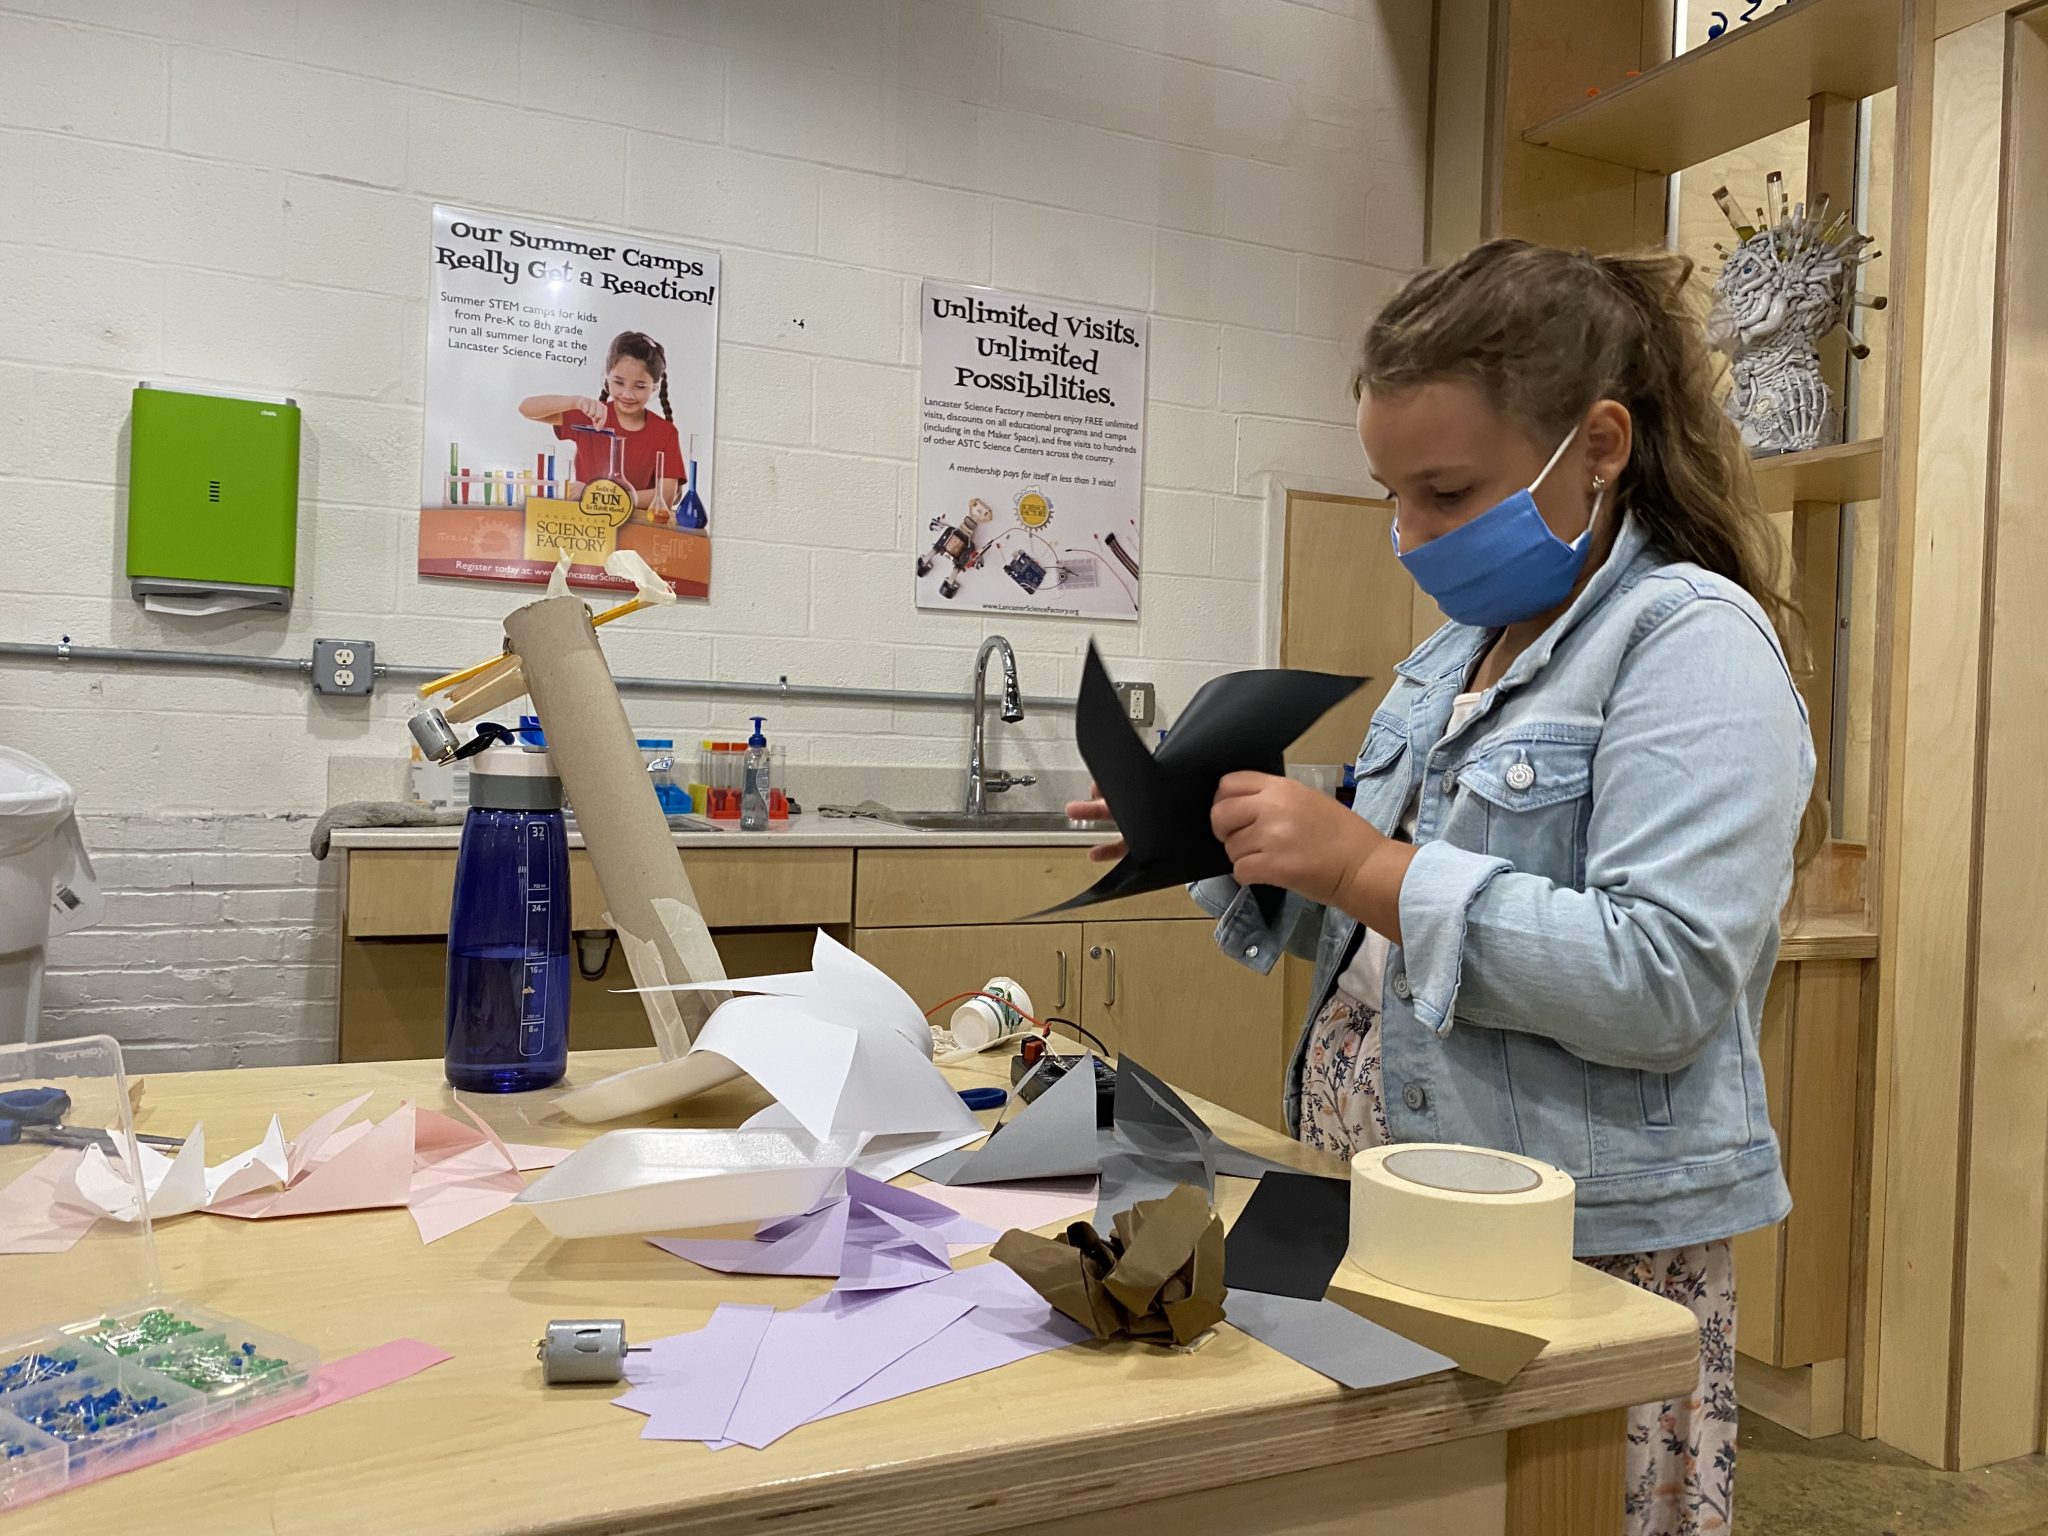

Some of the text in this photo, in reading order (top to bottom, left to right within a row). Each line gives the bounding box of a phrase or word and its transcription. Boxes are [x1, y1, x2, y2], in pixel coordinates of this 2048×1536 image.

[450, 222, 704, 279] Our Summer Camps
[434, 246, 715, 306] Really Get a Reaction!
[440, 291, 598, 323] Summer STEM camps for kids
[454, 308, 583, 336] from Pre-K to 8th grade
[930, 296, 1140, 348] Unlimited Visits.
[448, 338, 587, 367] Lancaster Science Factory!
[449, 326, 588, 351] run all summer long at the
[975, 335, 1099, 375] Unlimited
[954, 366, 1116, 407] Possibilities.
[923, 410, 1127, 442] visits, discounts on all educational programs and camps
[924, 397, 1139, 430] Lancaster Science Factory members enjoy FREE unlimited
[923, 423, 962, 436] (including
[963, 427, 971, 435] in
[972, 428, 986, 437] the
[987, 429, 1012, 440] Maker
[1013, 432, 1040, 445] Space),
[1041, 437, 1055, 445] and
[1057, 437, 1072, 447] free
[1073, 441, 1091, 449] visits
[1103, 443, 1137, 454] hundreds
[923, 435, 1115, 465] of other ASTC Science Centers across the country.
[949, 463, 955, 471] A
[956, 465, 1001, 478] membership
[1003, 470, 1019, 479] pays
[1021, 470, 1032, 480] for
[1033, 471, 1050, 482] itself
[1059, 474, 1072, 483] less
[1074, 476, 1089, 484] than
[1091, 477, 1097, 485] 3
[1098, 480, 1117, 488] visits!
[591, 492, 622, 506] FUN
[536, 520, 606, 540] SCIENCE
[536, 534, 606, 553] FACTORY
[455, 560, 494, 573] Register
[495, 565, 520, 576] today
[532, 826, 545, 837] 32
[532, 904, 541, 912] 24
[530, 966, 538, 974] 16
[528, 1025, 534, 1033] 8
